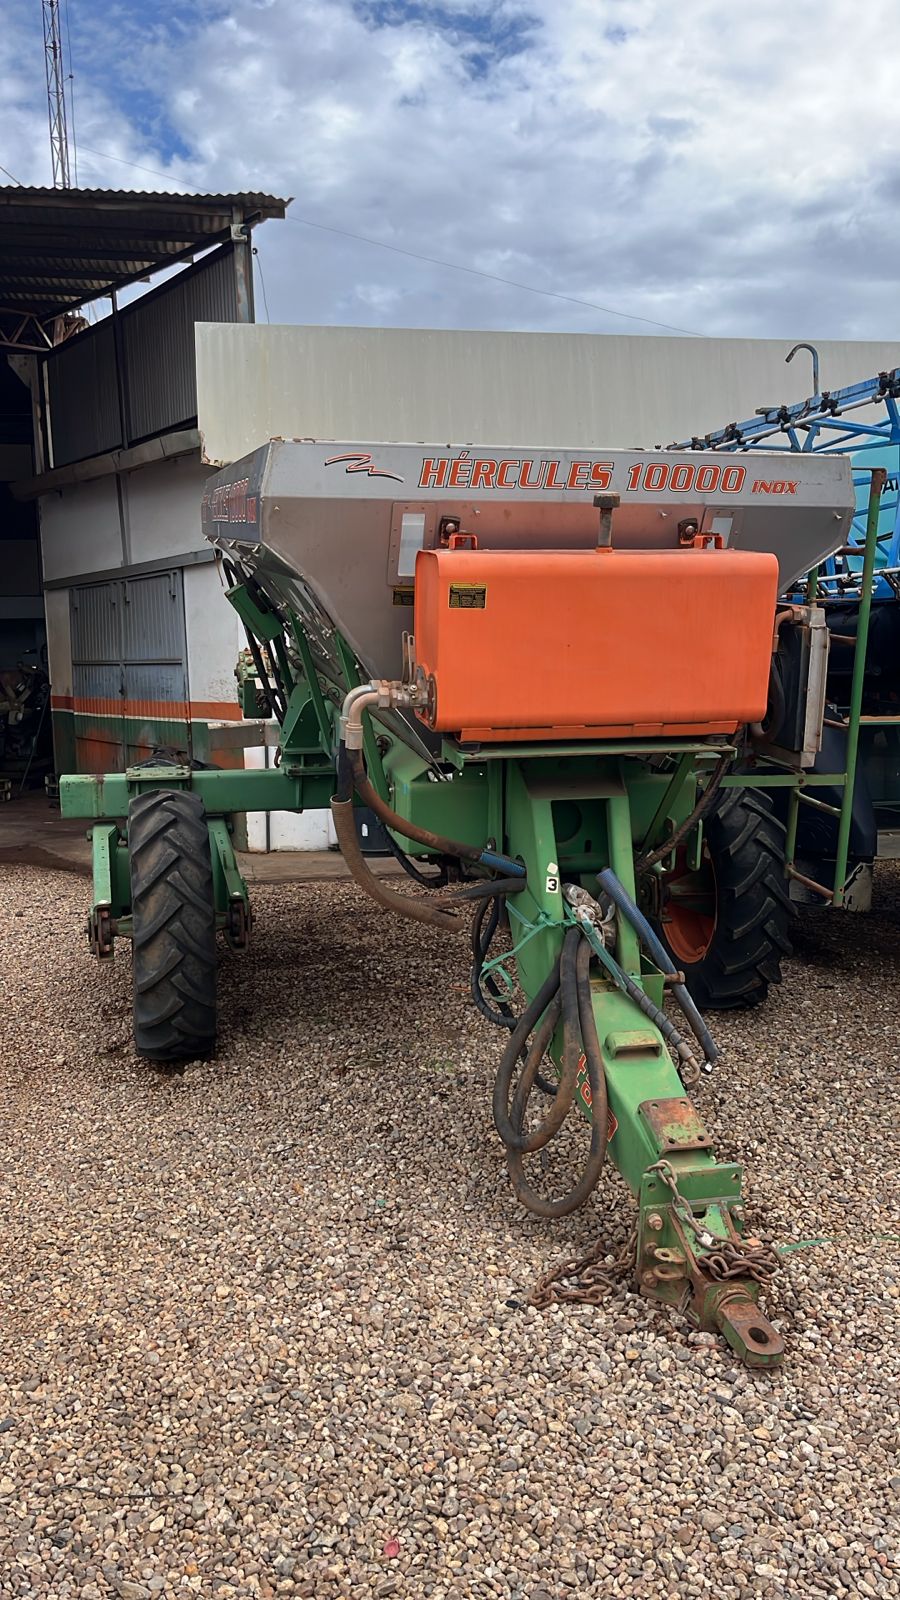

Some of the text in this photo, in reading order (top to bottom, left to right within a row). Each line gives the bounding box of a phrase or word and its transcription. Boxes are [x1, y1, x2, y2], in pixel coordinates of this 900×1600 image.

[418, 451, 802, 495] HÉRCULES 10000 INOX
[548, 878, 557, 891] 3
